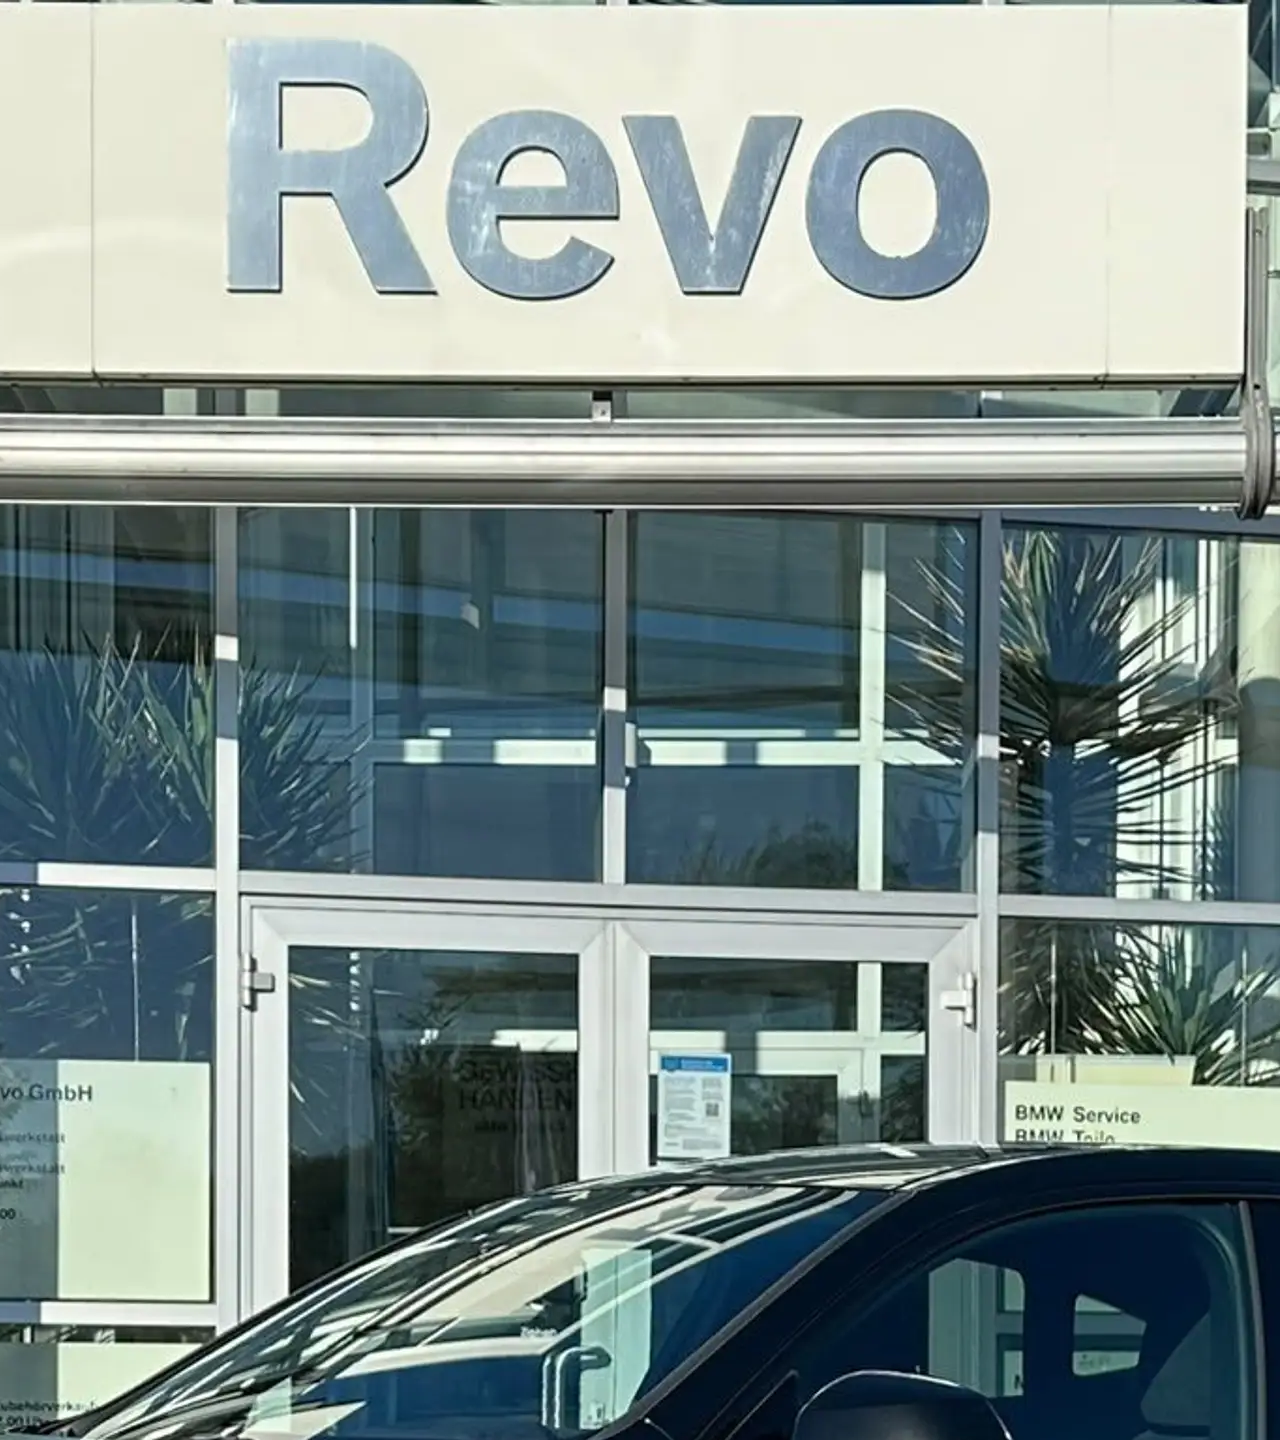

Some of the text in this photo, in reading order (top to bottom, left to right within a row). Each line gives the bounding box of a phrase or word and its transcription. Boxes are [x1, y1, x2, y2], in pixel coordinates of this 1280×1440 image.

[226, 37, 991, 301] Revo
[28, 1083, 93, 1102] GmbH
[1014, 1104, 1141, 1124] BMW Service
[1014, 1128, 1065, 1142] BMW
